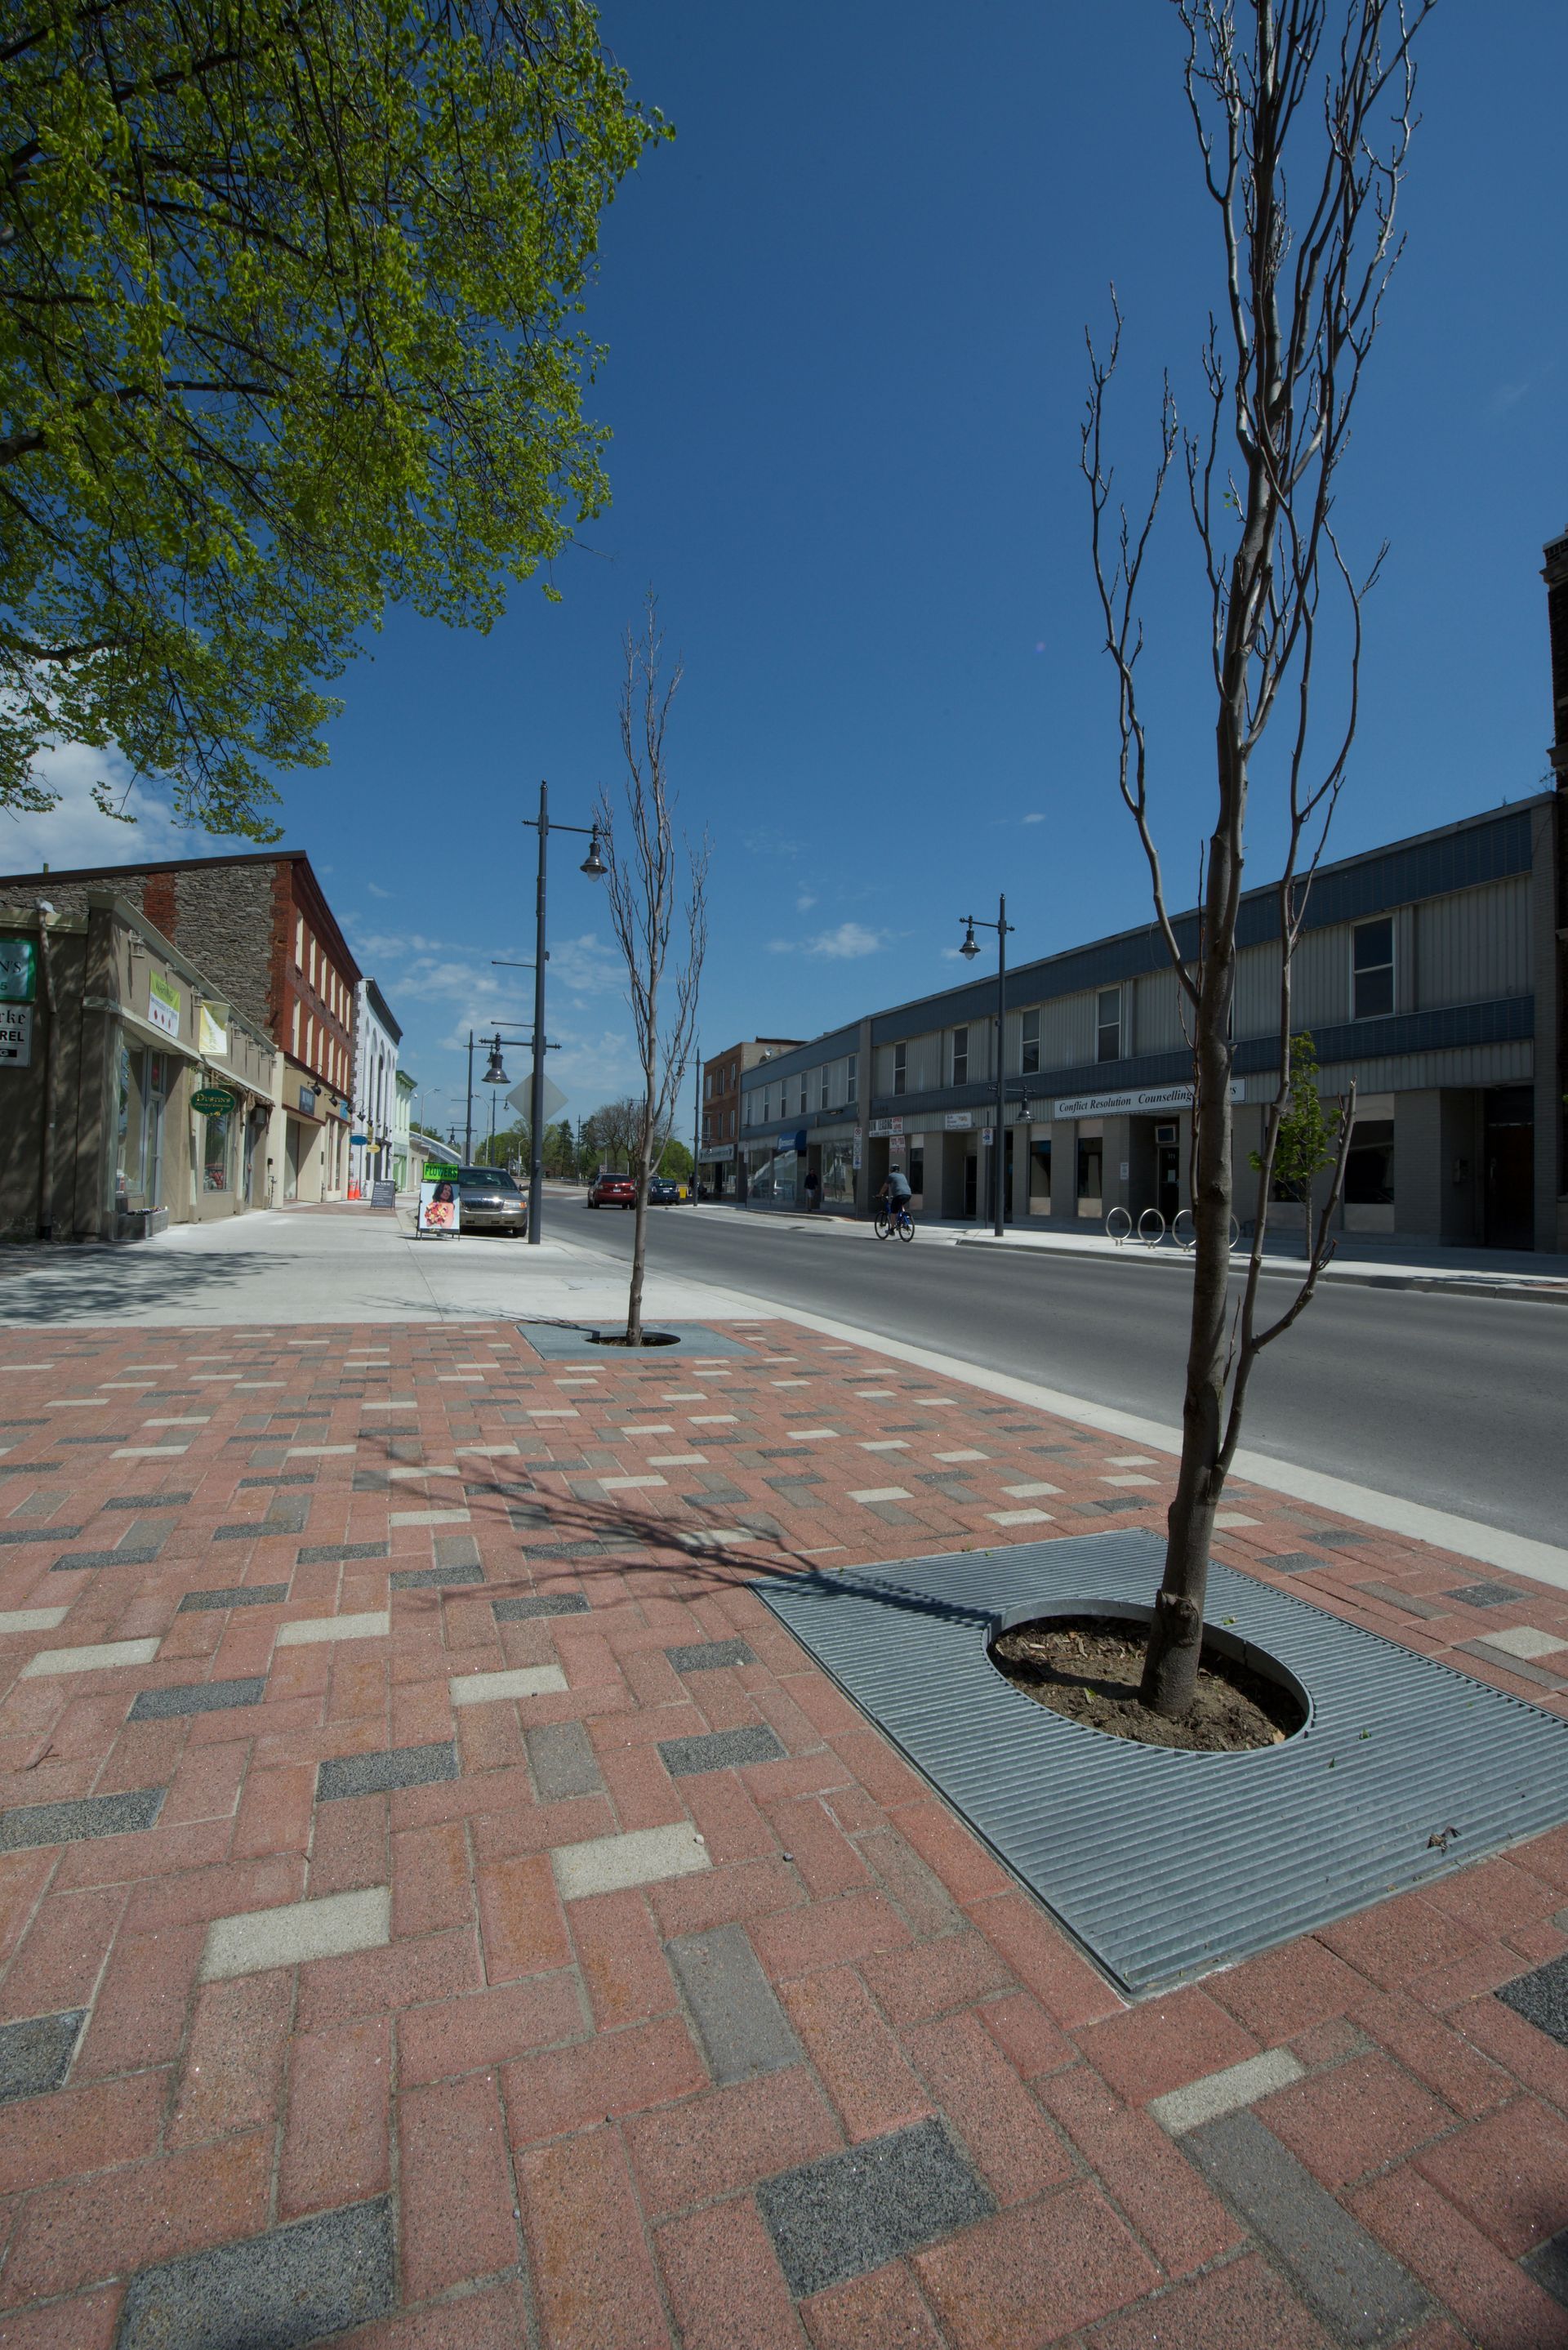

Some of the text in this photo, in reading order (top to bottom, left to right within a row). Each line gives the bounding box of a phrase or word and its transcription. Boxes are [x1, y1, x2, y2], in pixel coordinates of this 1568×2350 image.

[1059, 1089, 1193, 1113] Conflict Resolution Counselling
[425, 1165, 457, 1177] FLOWERS
